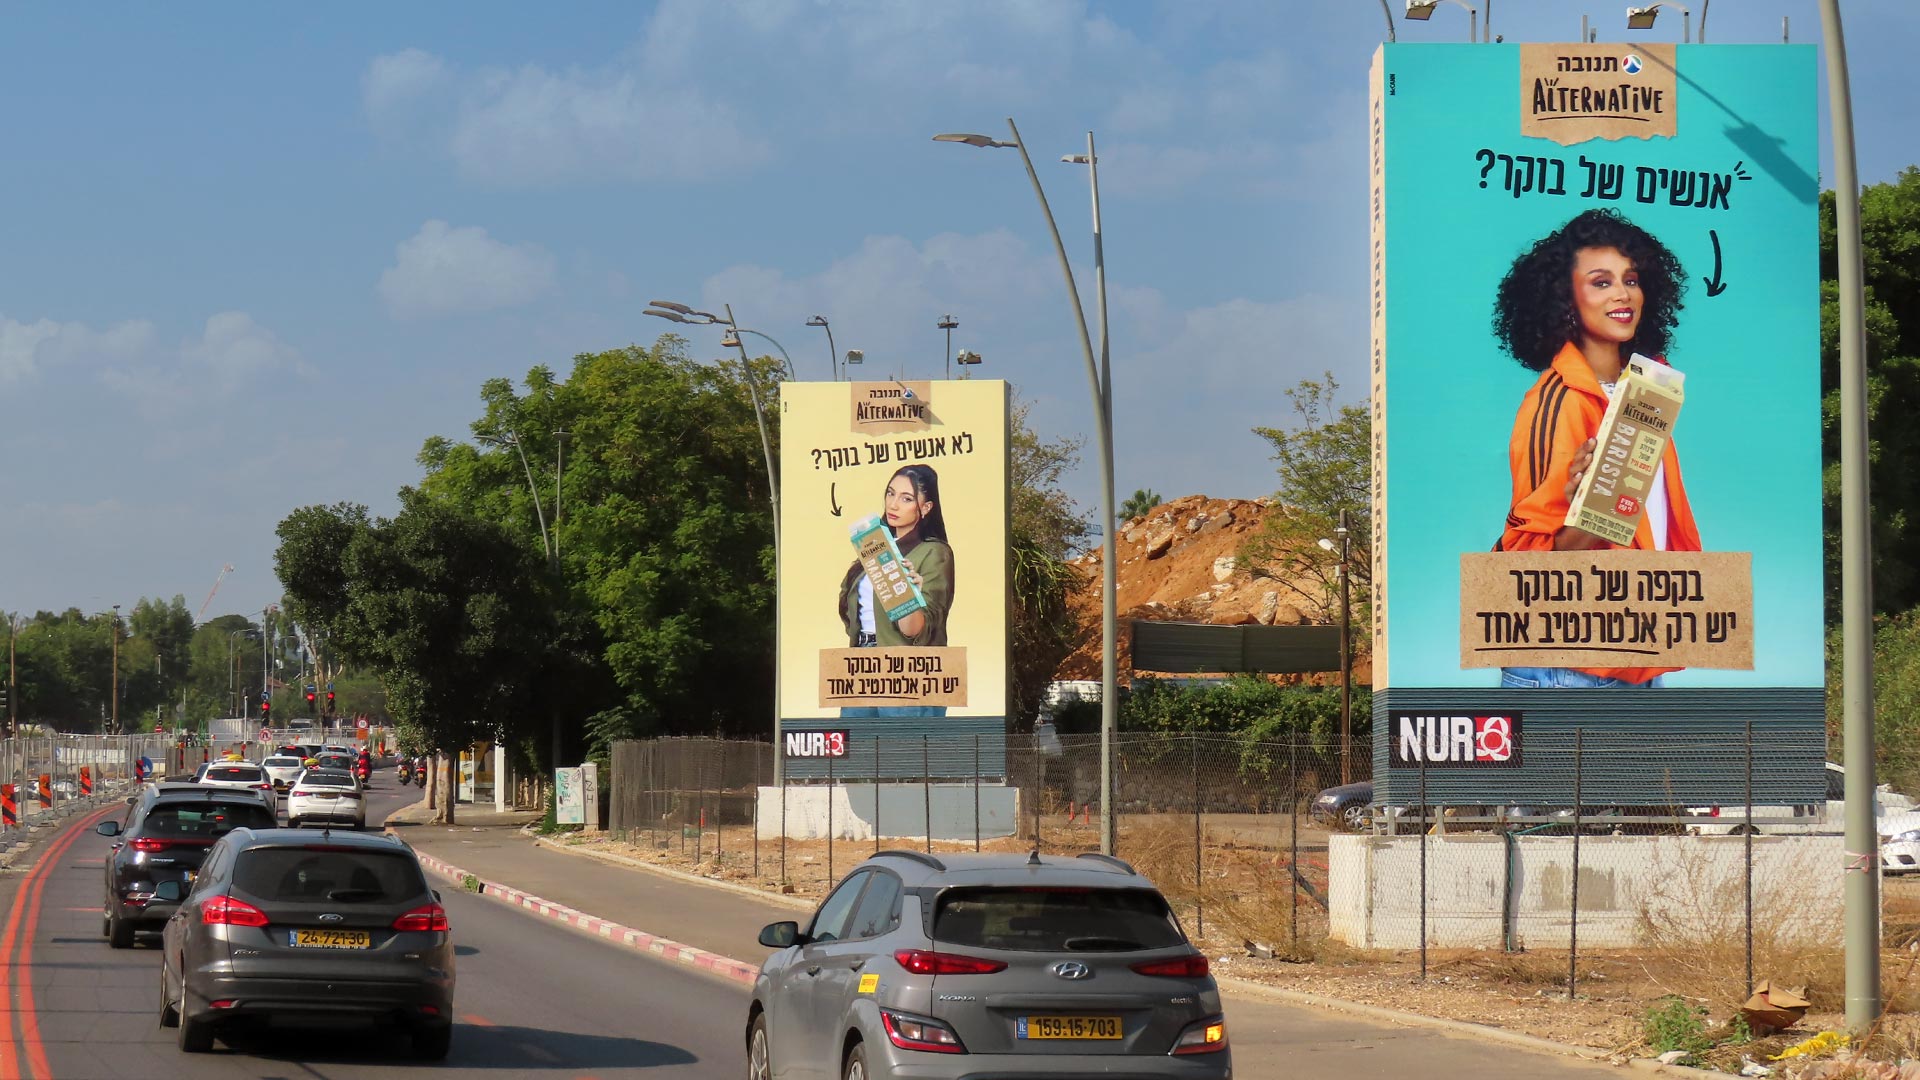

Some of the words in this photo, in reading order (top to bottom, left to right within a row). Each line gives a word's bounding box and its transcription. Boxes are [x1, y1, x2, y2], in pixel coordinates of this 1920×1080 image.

[1557, 56, 1618, 72] תנובה
[1475, 148, 1567, 199] בוקר?
[1578, 155, 1625, 201] של
[1635, 166, 1732, 211] אנשים
[869, 389, 901, 399] תנובה
[864, 442, 890, 465] של
[894, 437, 947, 461] אנשים
[951, 431, 974, 455] לא
[810, 446, 861, 472] בוקר?
[1592, 422, 1637, 497] BARISTA
[865, 558, 893, 603] BARISTA
[1509, 569, 1583, 608] הבוקר
[1590, 564, 1629, 602] של
[1637, 569, 1705, 608] בקפה
[1476, 611, 1530, 644] אחד
[1538, 606, 1657, 644] אלטרנטיב
[1665, 611, 1697, 649] רק
[1706, 611, 1737, 643] יש
[843, 656, 881, 677] הבוקר
[884, 654, 904, 674] של
[908, 656, 943, 676] בקפה
[826, 678, 854, 695] אחד
[858, 675, 919, 695] אלטרנטיב
[922, 677, 939, 697] רק
[942, 677, 959, 694] יש
[785, 732, 826, 757] NUR
[1400, 716, 1474, 762] NUR
